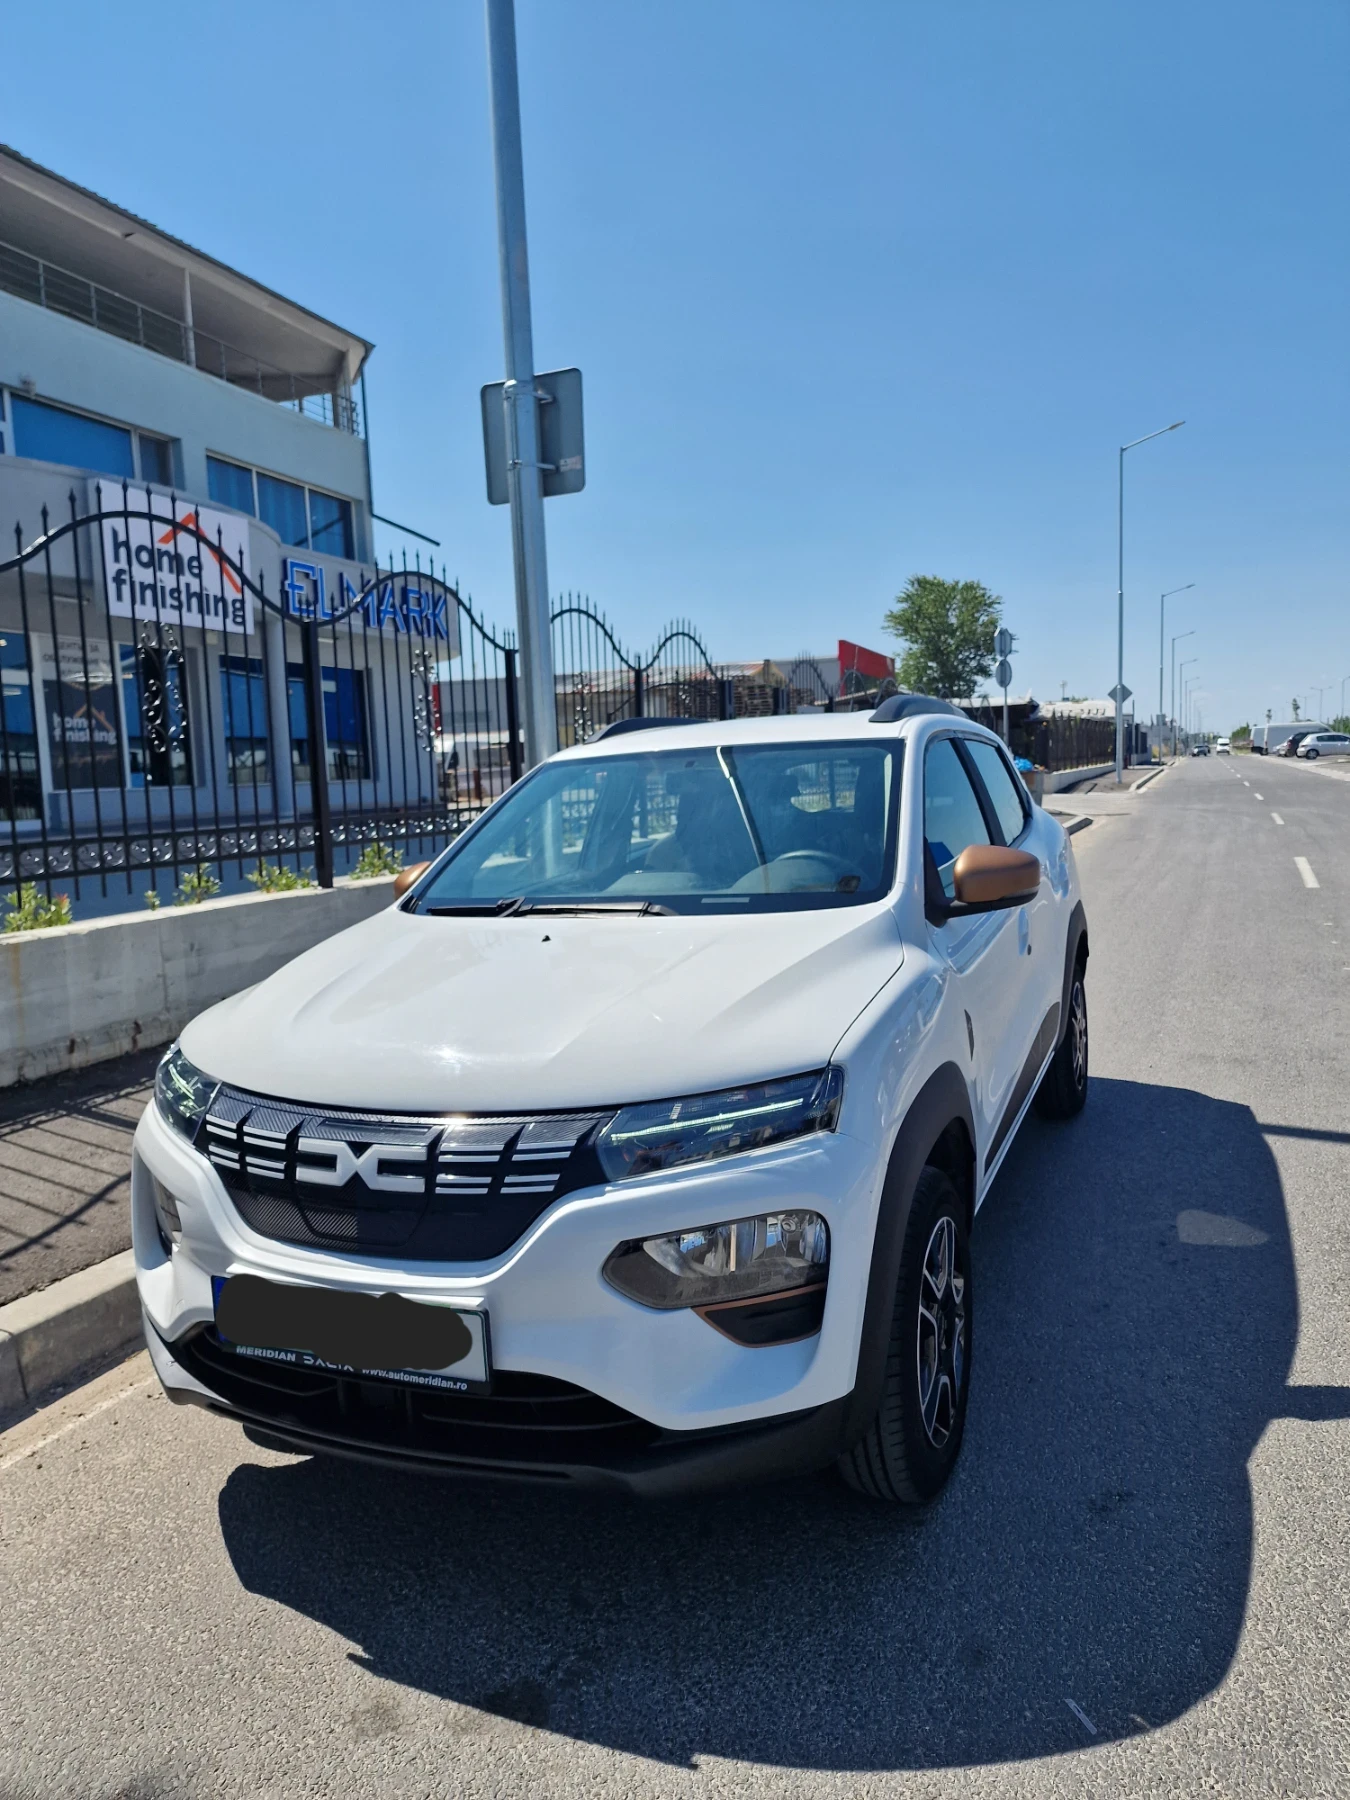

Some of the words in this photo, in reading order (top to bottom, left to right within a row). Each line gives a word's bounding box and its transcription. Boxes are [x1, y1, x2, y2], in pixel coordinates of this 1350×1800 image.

[112, 526, 203, 579] home
[282, 558, 449, 639] ELMARK
[53, 728, 117, 745] fnishing
[236, 1345, 296, 1362] MERIDIAN
[362, 1368, 468, 1391] www.automeridian.ro
